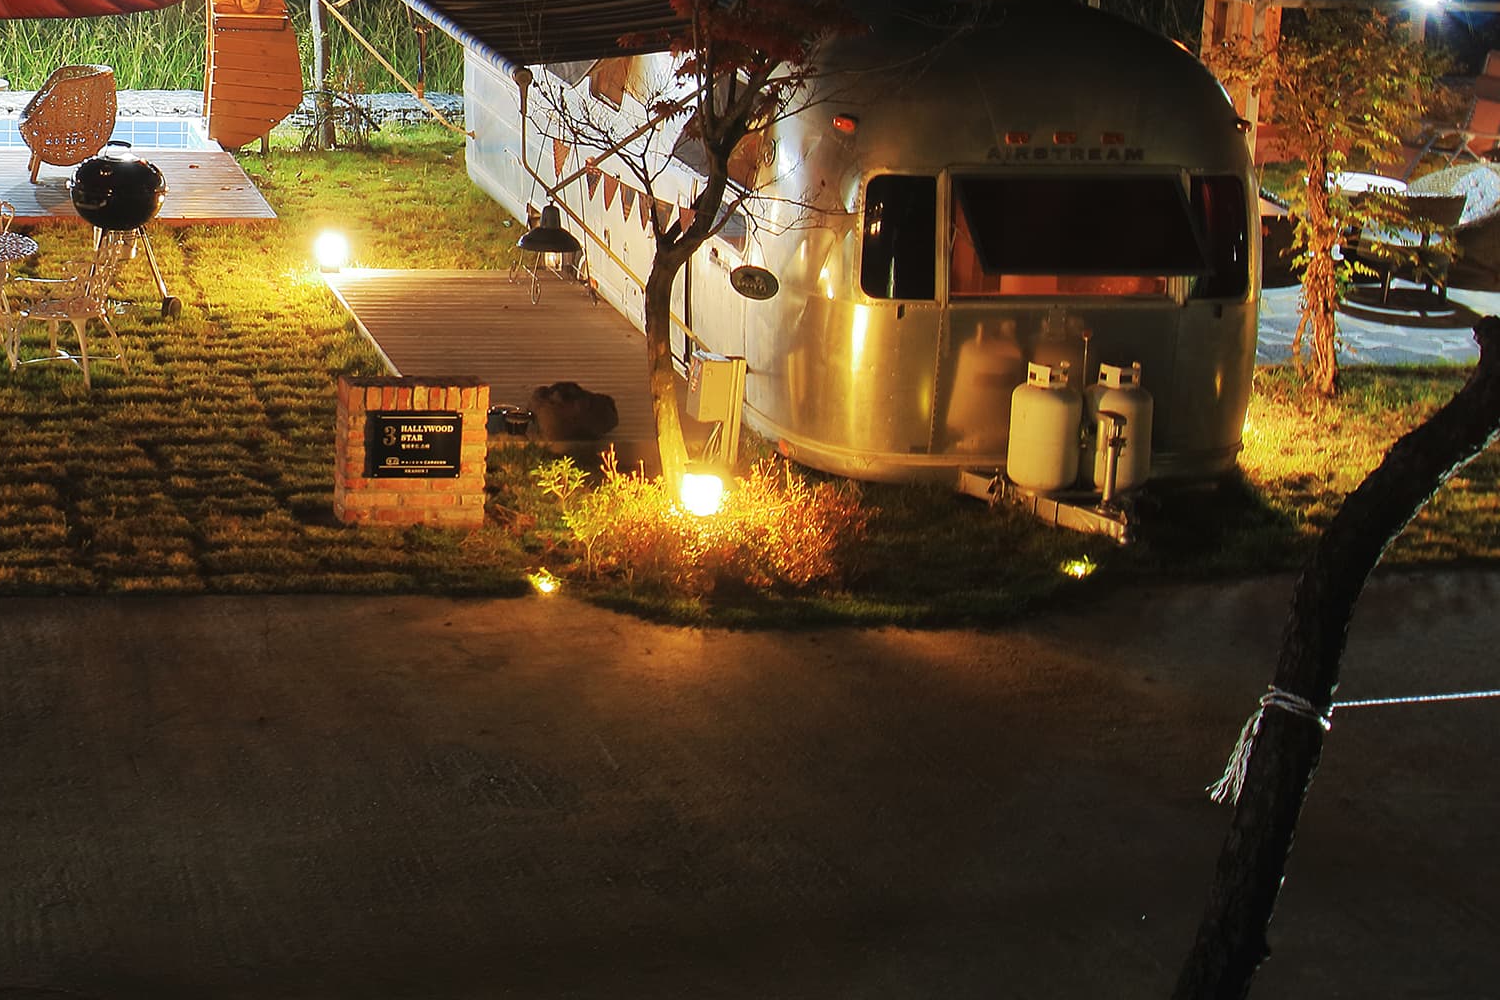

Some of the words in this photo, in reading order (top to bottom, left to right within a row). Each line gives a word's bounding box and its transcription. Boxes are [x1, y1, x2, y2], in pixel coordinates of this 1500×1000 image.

[987, 147, 1144, 160] AIRSTREAM
[401, 425, 454, 433] HALLYWOOD
[383, 426, 396, 446] 3
[401, 434, 423, 442] STAR
